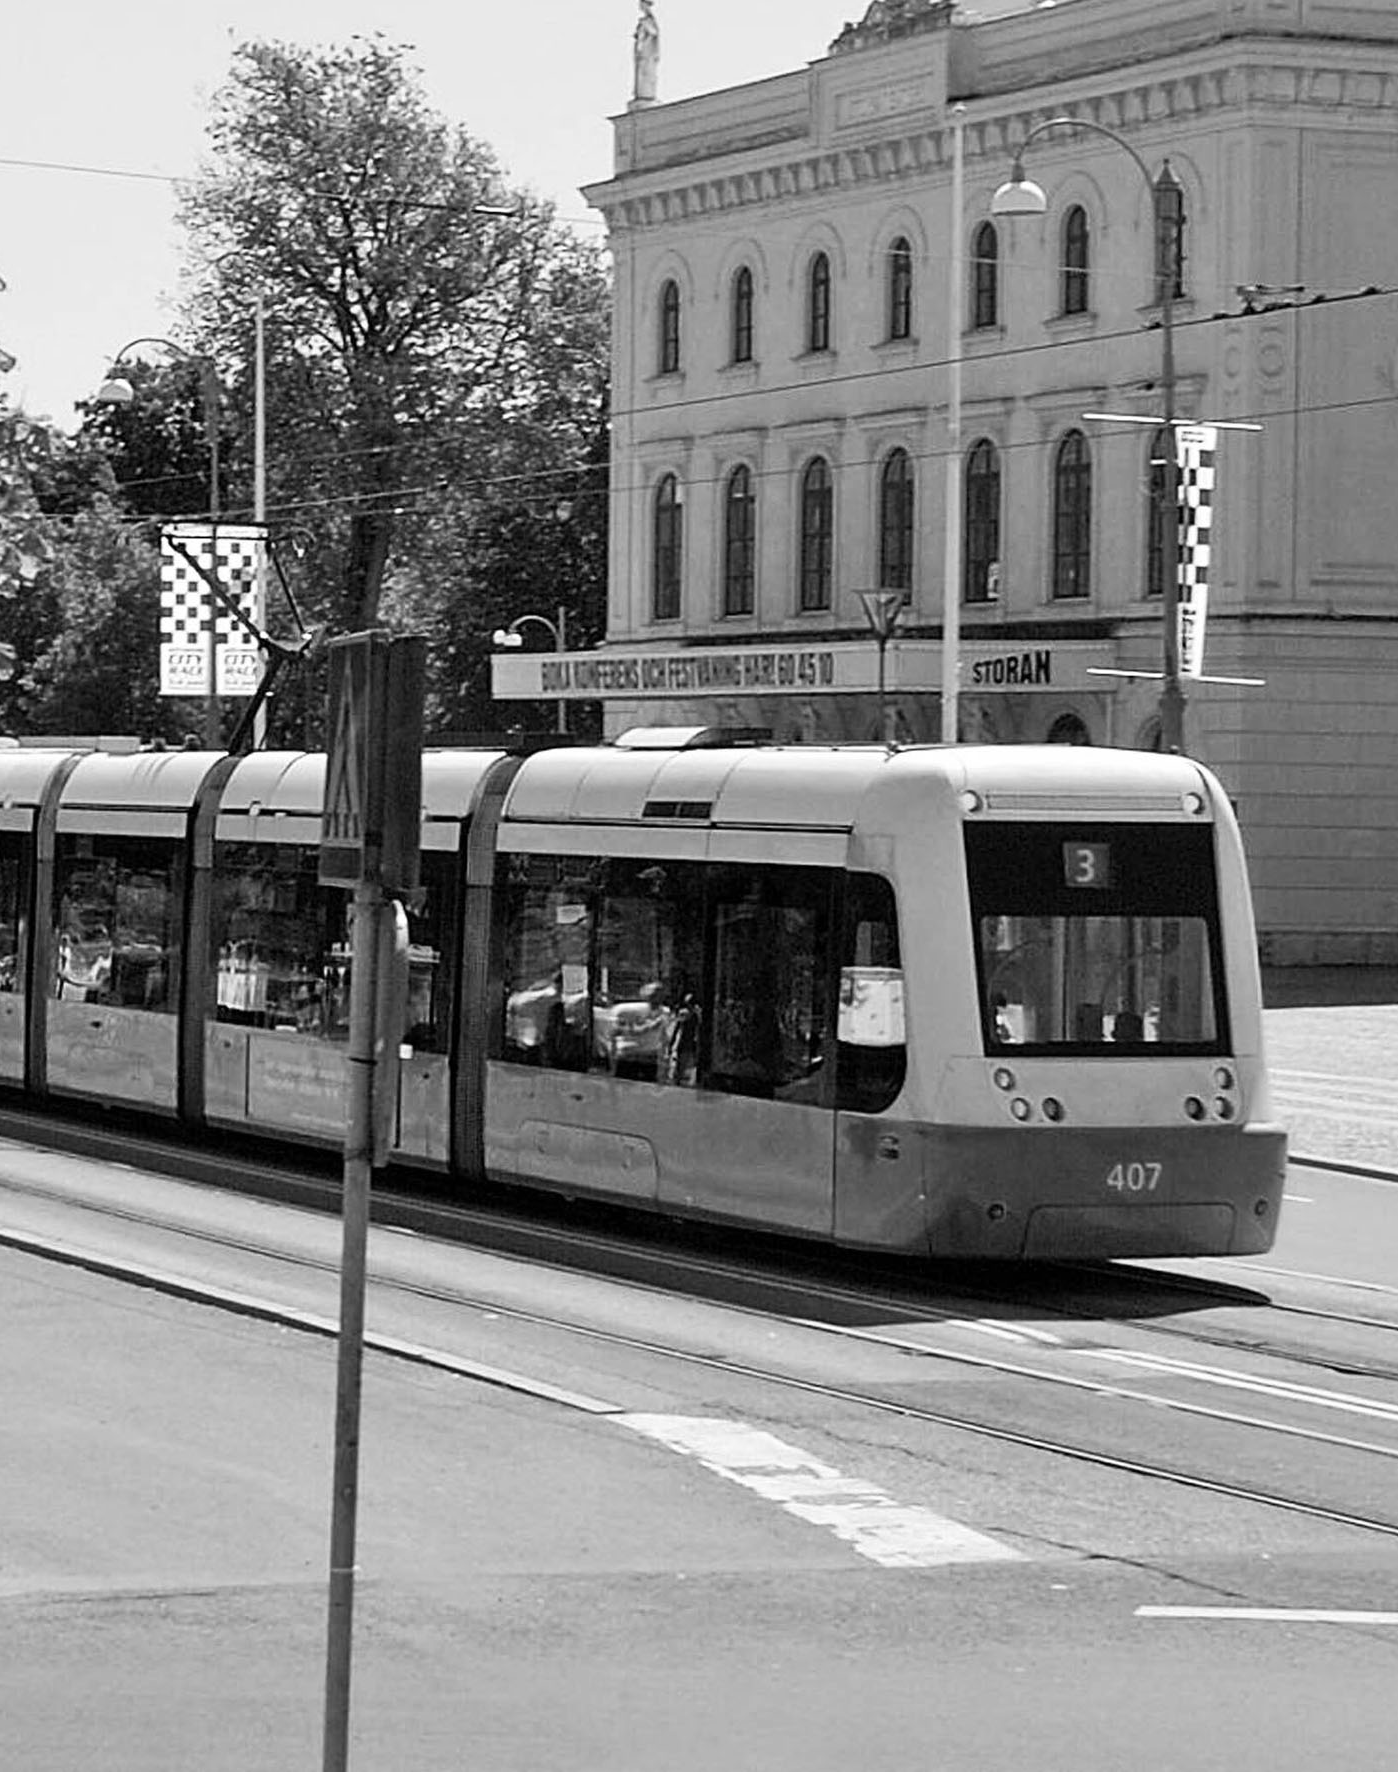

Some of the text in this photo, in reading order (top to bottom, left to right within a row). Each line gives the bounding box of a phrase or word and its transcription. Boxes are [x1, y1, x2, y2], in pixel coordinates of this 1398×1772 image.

[168, 654, 201, 665] CITY
[542, 661, 570, 690] BOKA
[574, 659, 639, 689] KONFERENS
[642, 657, 665, 688] OCH
[778, 652, 795, 685] 60
[797, 651, 817, 685] 45
[819, 651, 834, 685] 10
[972, 650, 1051, 684] STORAN
[1076, 849, 1095, 882] 3
[1107, 1163, 1162, 1191] 407
